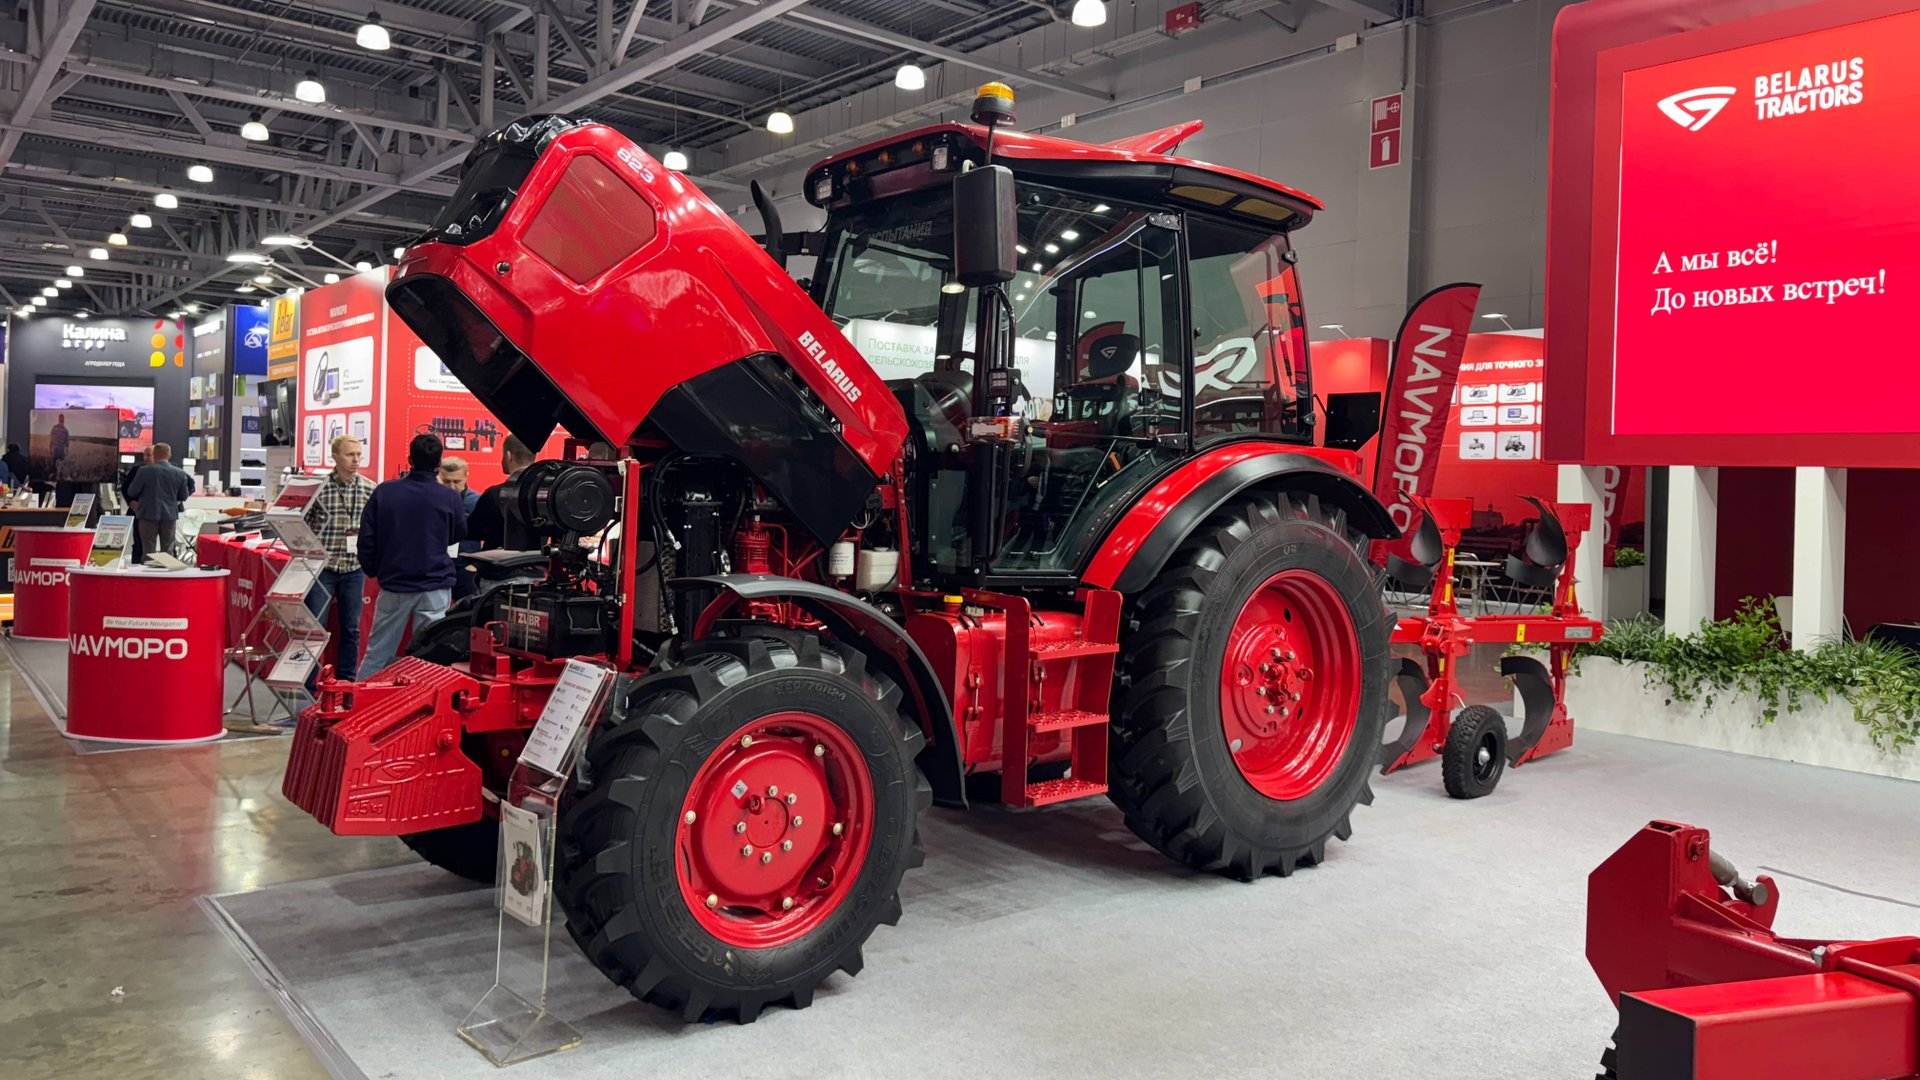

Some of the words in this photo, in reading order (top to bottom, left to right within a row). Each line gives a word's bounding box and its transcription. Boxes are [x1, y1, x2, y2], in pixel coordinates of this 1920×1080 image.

[1755, 56, 1864, 97] BELARUS
[1754, 81, 1863, 120] TRACTORS
[617, 147, 655, 184] 823
[1652, 251, 1673, 274] А
[1681, 252, 1718, 272] мы
[1726, 239, 1777, 267] всё!
[1651, 287, 1686, 316] До
[1693, 284, 1775, 308] новых
[1782, 269, 1886, 304] встреч!
[62, 339, 106, 351] агро
[63, 323, 126, 340] Калина
[797, 330, 862, 403] BELARUS
[1494, 359, 1534, 369] ТОЧНОГО
[69, 633, 188, 660] NAVMOPO
